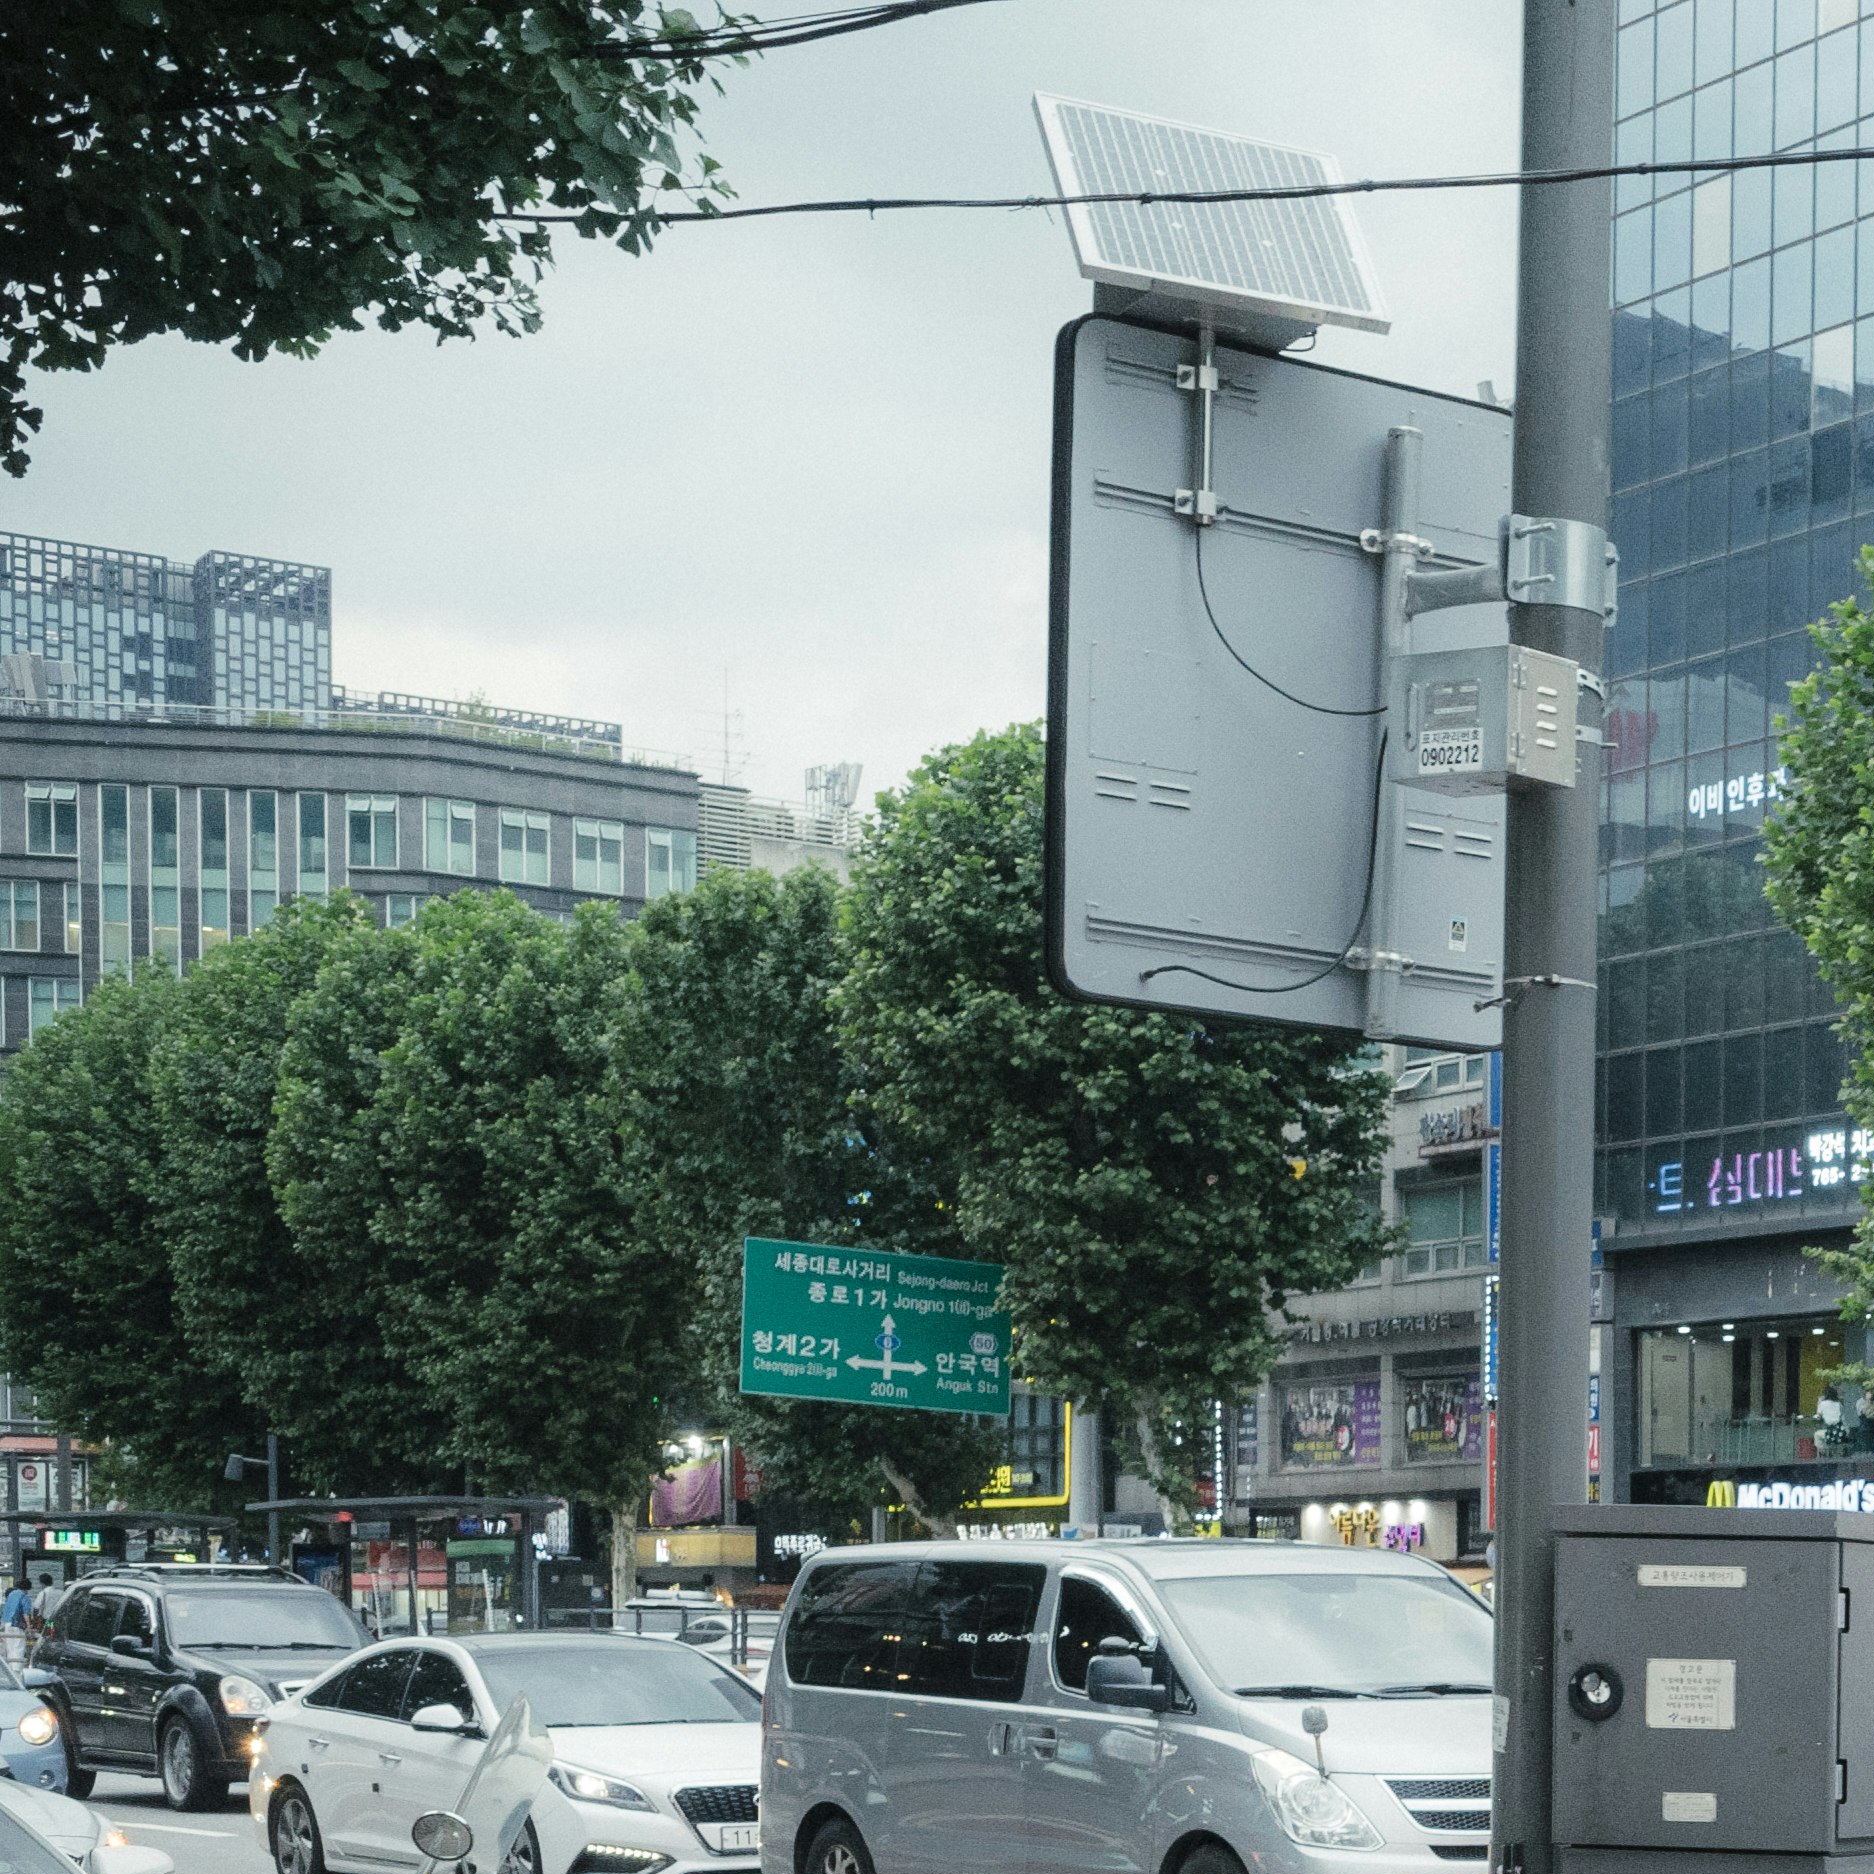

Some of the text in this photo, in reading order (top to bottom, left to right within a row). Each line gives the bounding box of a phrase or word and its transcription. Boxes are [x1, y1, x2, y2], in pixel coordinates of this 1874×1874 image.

[1422, 729, 1480, 743] 표지관리번호
[1421, 744, 1479, 766] 0902212
[775, 1252, 891, 1282] 세종대로사거리
[808, 1282, 888, 1310] 종로1가
[893, 1296, 944, 1315] Jongno
[752, 1331, 840, 1359] 청계2가
[935, 1352, 1000, 1378] 안국역
[870, 1382, 908, 1398] 200m
[936, 1377, 999, 1394] Anguk Stn
[734, 1830, 751, 1845] 11
